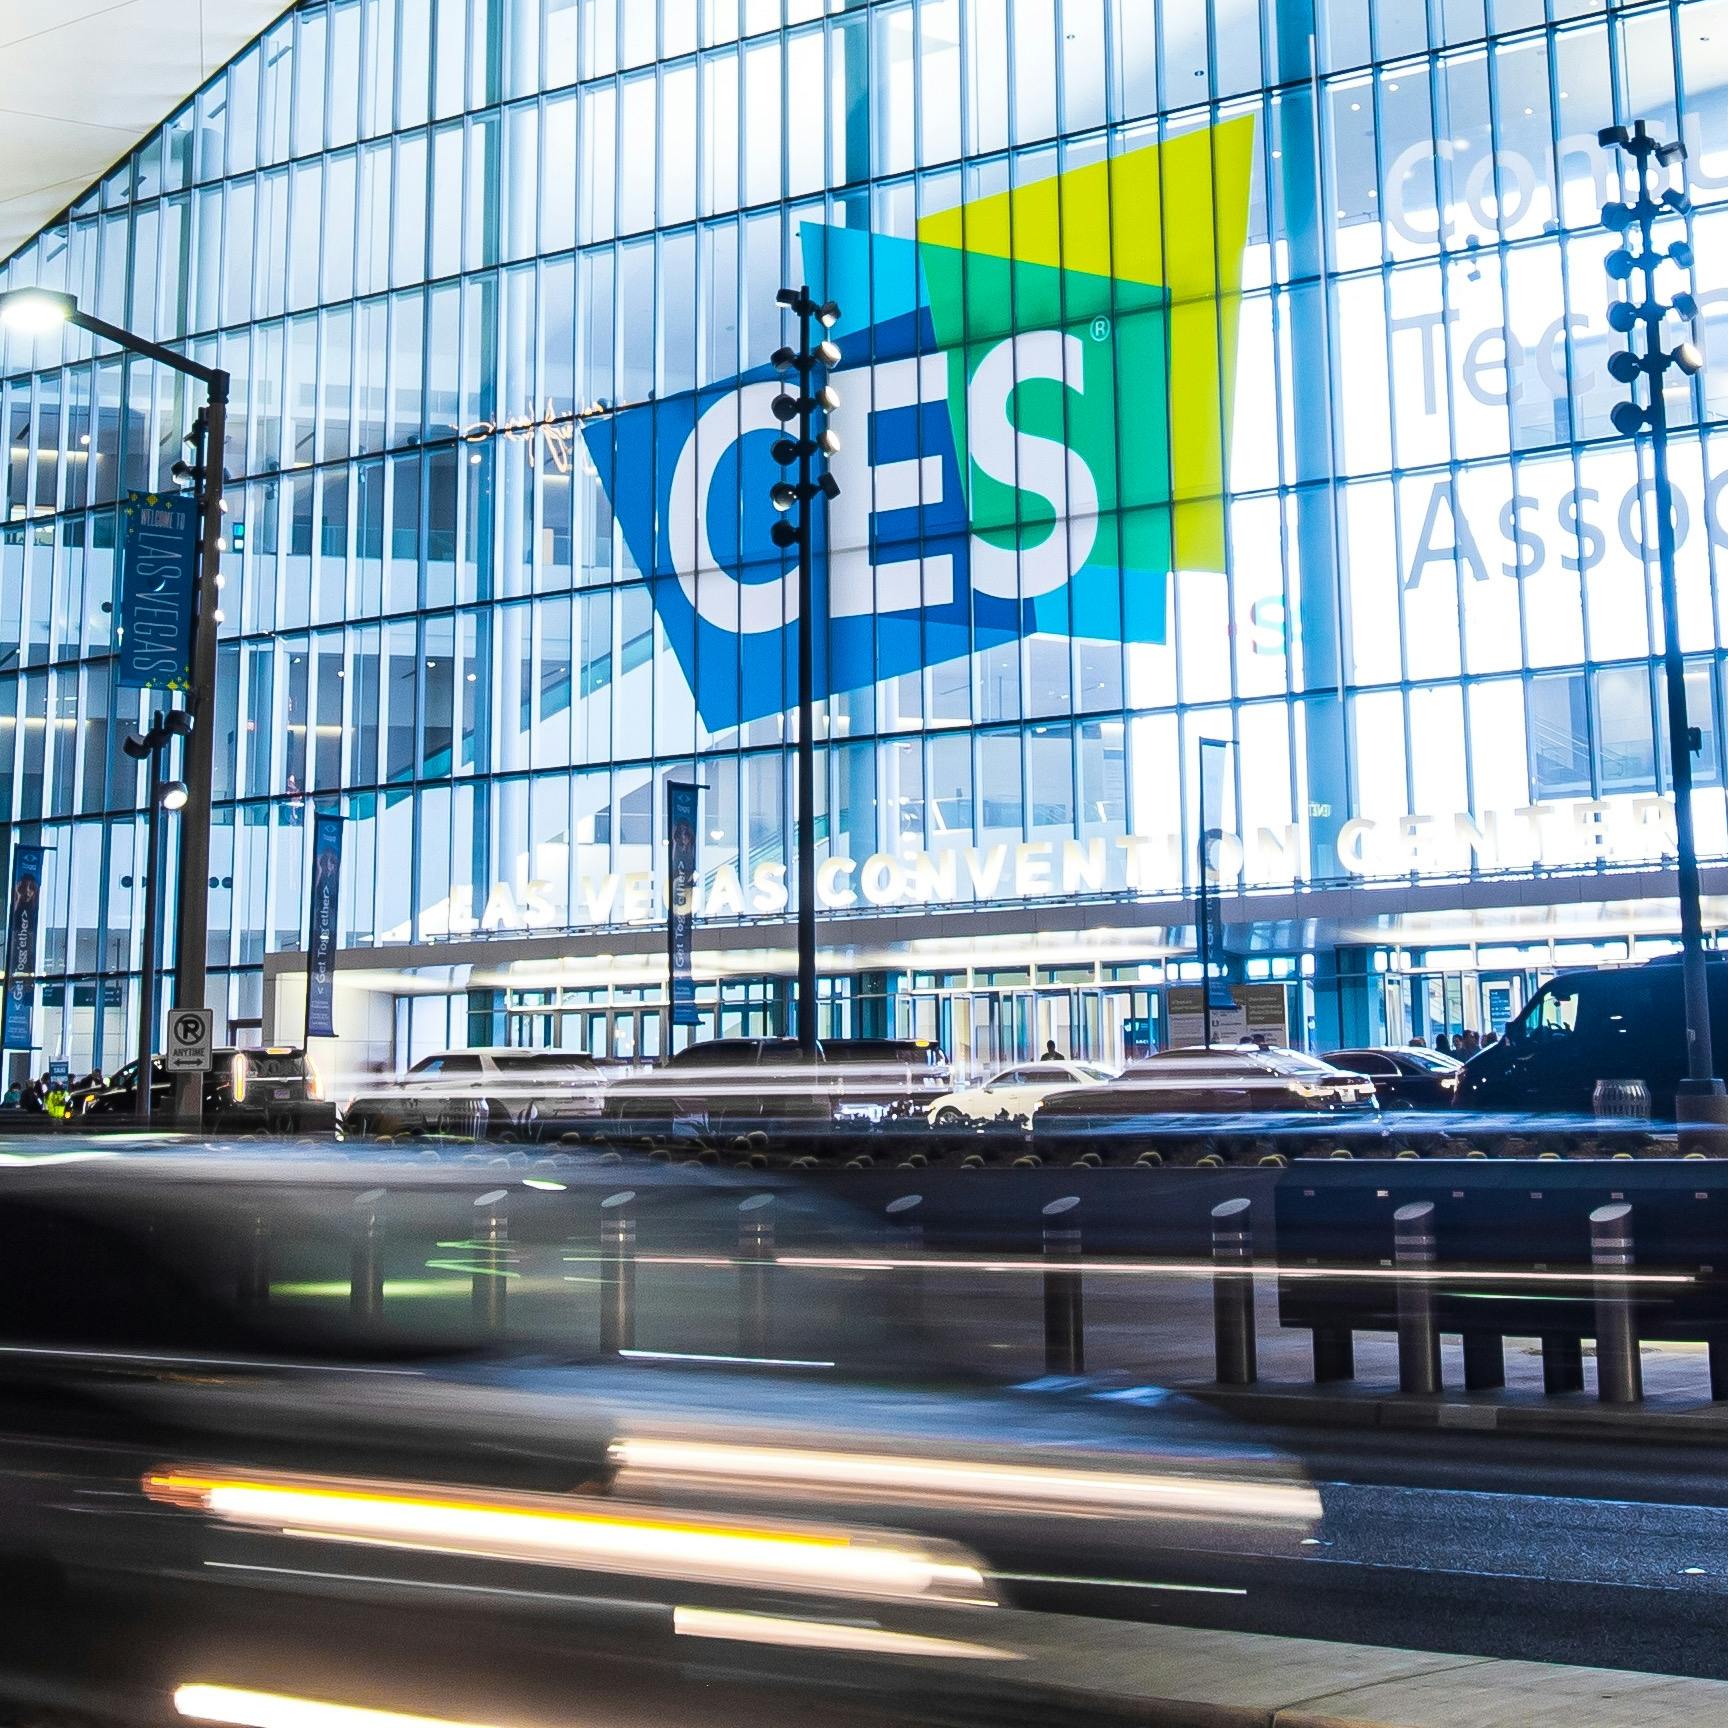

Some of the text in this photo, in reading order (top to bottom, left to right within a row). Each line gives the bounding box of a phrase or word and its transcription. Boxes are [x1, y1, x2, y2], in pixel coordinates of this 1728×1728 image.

[133, 532, 183, 673] LAS VEGAS
[448, 879, 558, 932] LAS
[815, 821, 1304, 909] CONVENTION
[1336, 798, 1680, 873] CENTER
[173, 1048, 206, 1057] ANYTIME
